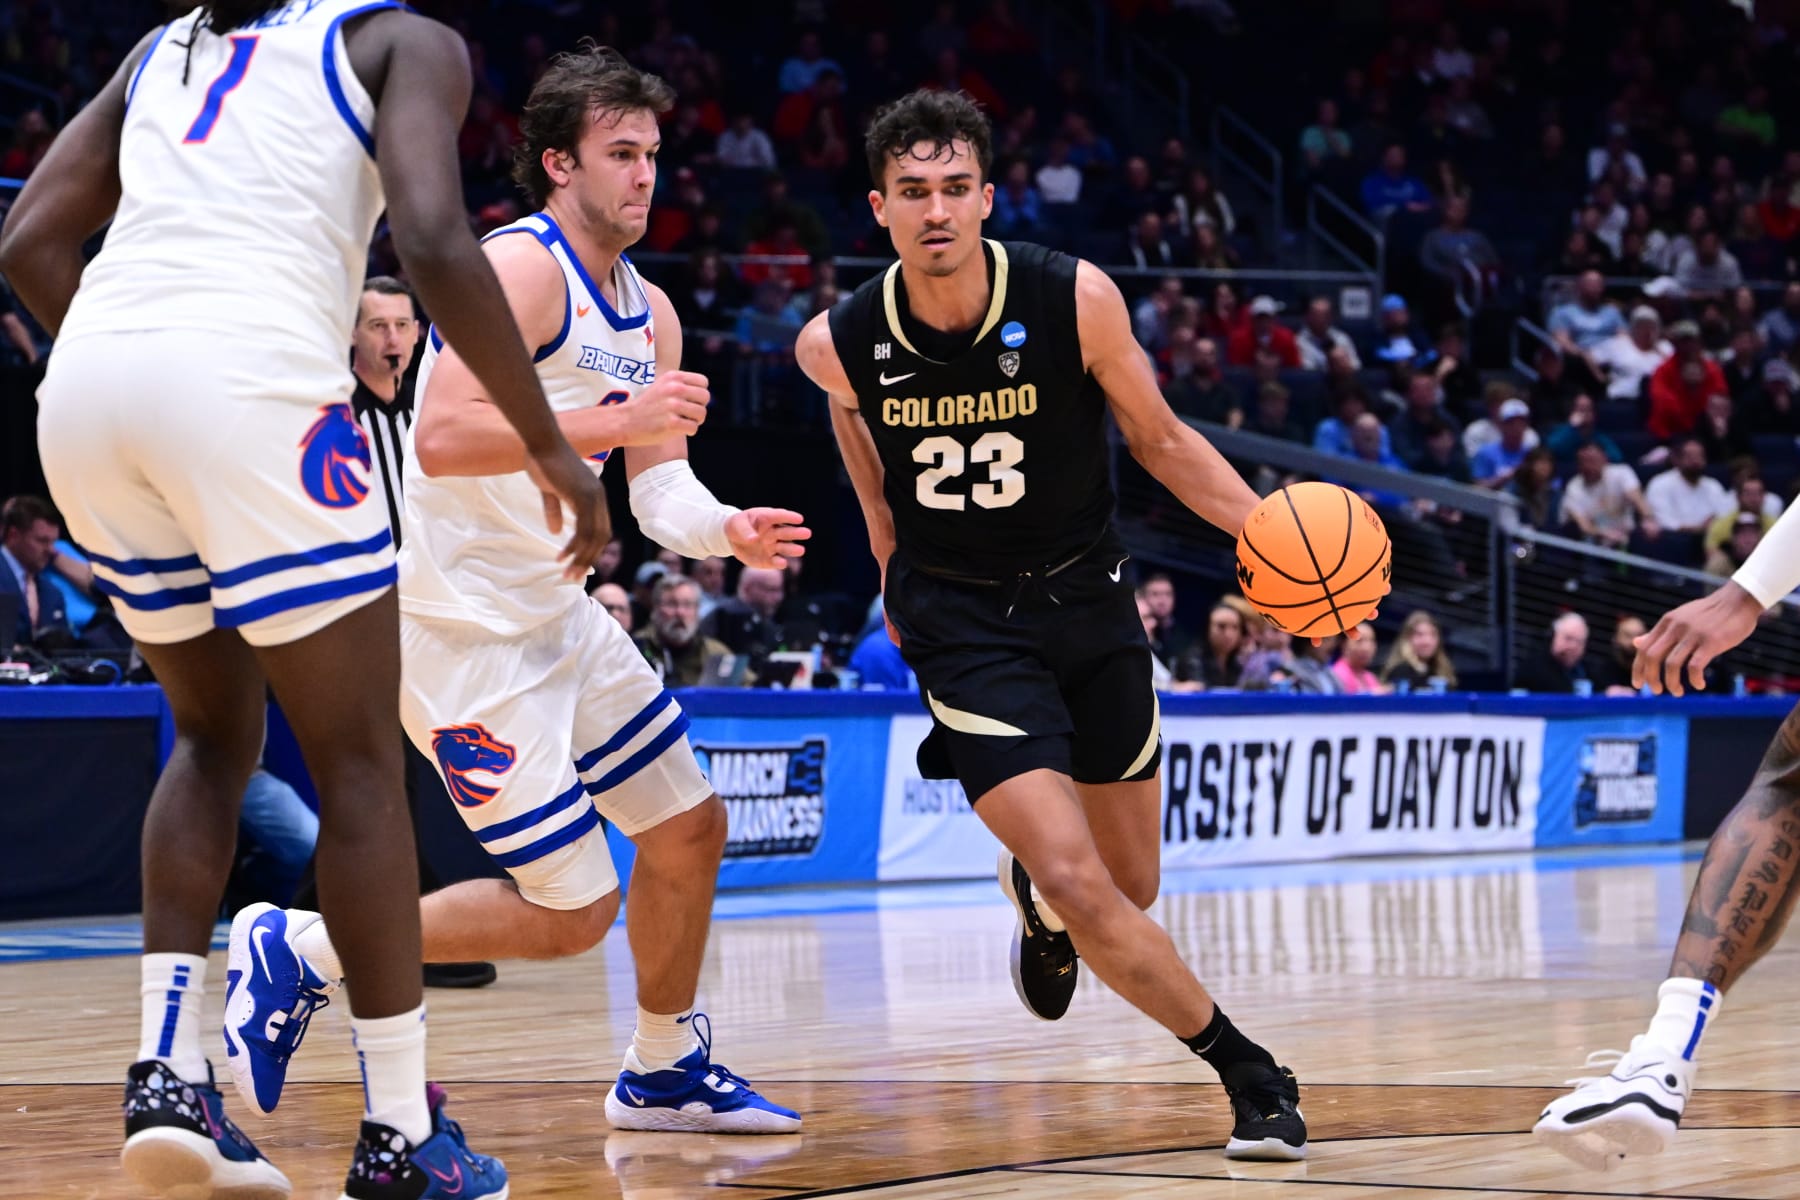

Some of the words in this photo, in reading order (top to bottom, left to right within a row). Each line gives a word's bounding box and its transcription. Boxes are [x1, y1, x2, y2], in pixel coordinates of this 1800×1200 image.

[182, 34, 261, 144] 1
[874, 342, 891, 360] BH
[1005, 331, 1026, 344] NCAA
[882, 383, 1037, 428] COLORADO
[912, 431, 1026, 511] 23
[710, 752, 789, 796] MARCH
[1164, 738, 1292, 843] RSITY
[1306, 737, 1358, 835] OF
[1370, 736, 1524, 831] DAYTON
